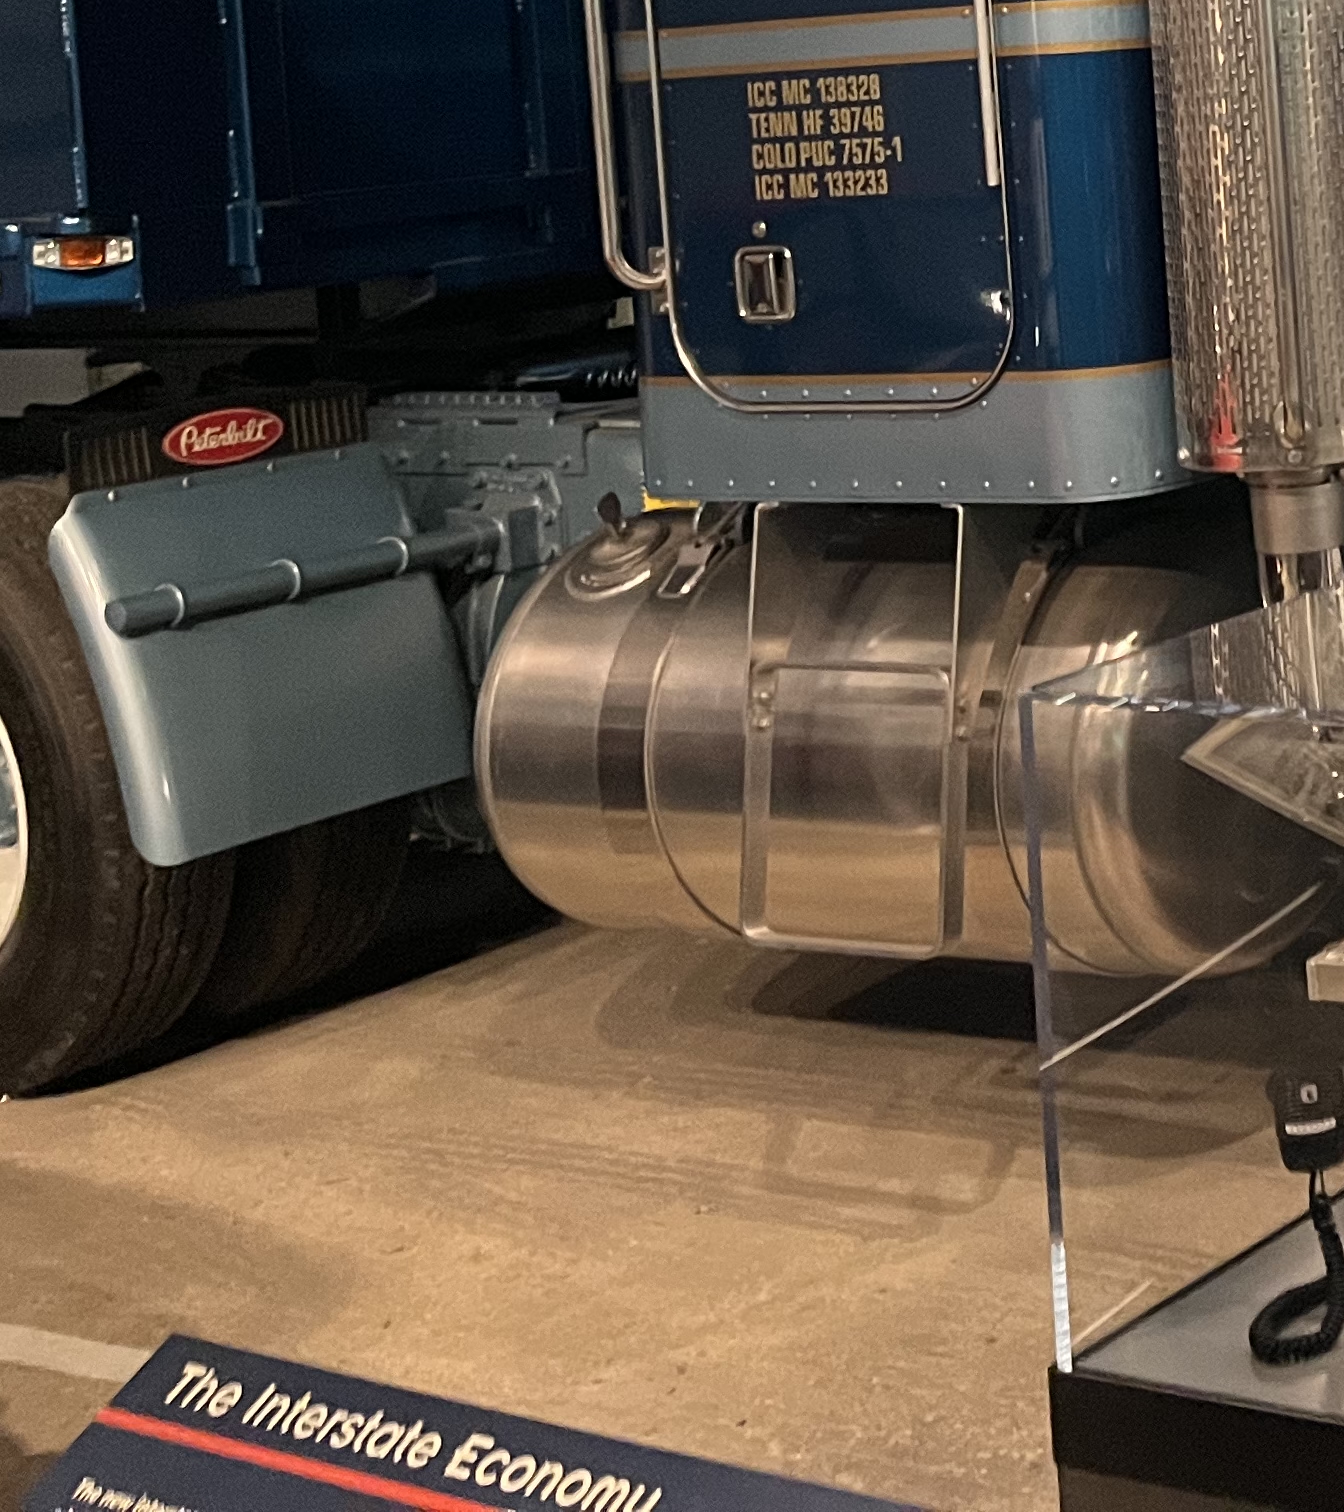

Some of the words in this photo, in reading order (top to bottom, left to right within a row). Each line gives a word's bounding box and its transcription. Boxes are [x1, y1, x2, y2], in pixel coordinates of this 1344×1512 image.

[747, 81, 777, 108] ICC
[781, 78, 812, 105] MC
[817, 73, 881, 103] 138328
[749, 110, 798, 138] TENN
[802, 109, 824, 136] HF
[829, 105, 885, 135] 39746
[752, 142, 796, 170] COLO
[799, 140, 835, 167] PUC
[755, 174, 785, 201] ICC
[789, 172, 818, 199] MC
[824, 168, 888, 197] 133233
[180, 417, 273, 457] Peterbilt
[164, 1361, 243, 1418] The
[241, 1382, 442, 1469] Interstate
